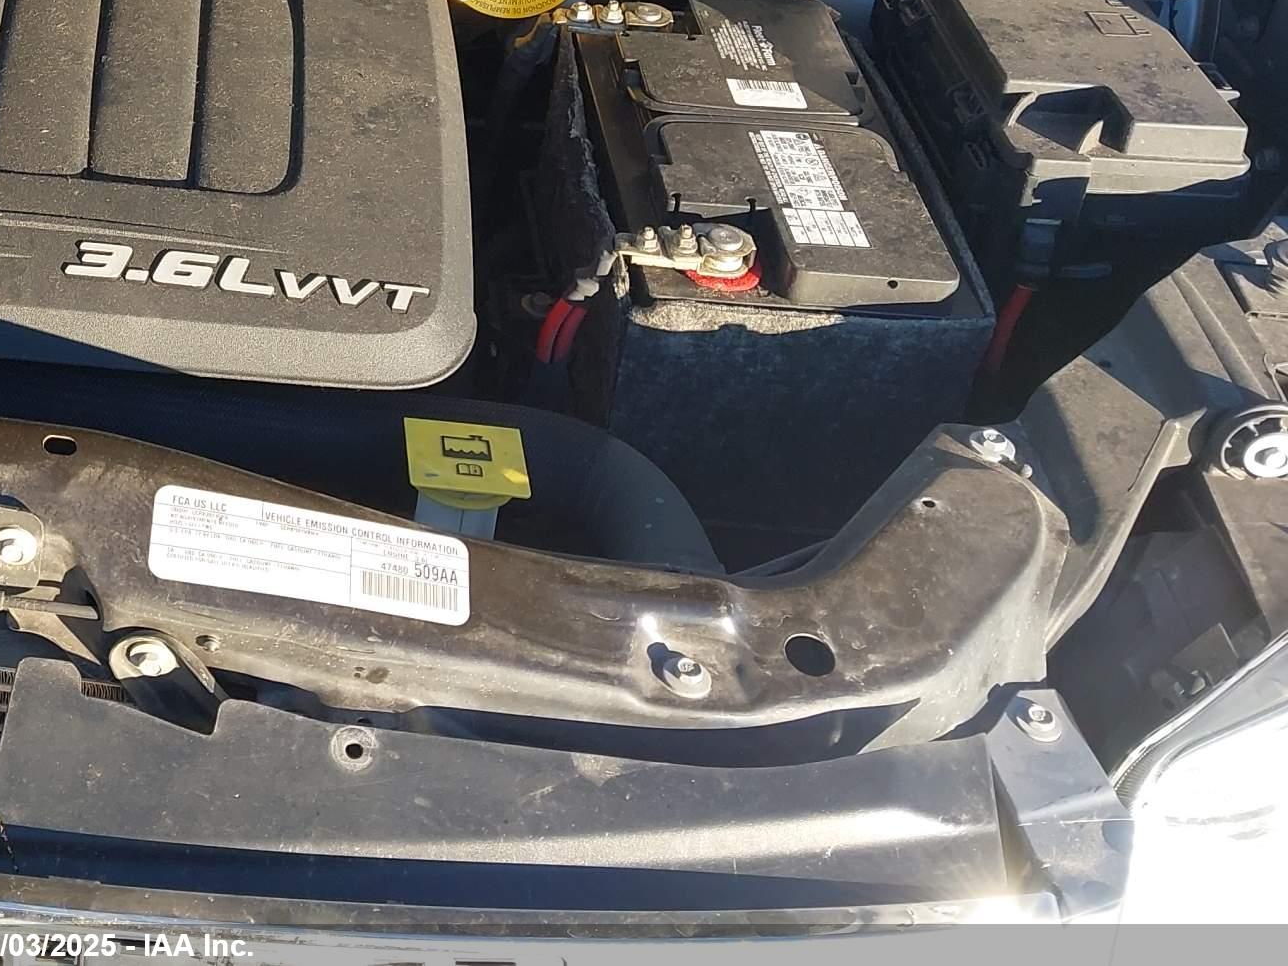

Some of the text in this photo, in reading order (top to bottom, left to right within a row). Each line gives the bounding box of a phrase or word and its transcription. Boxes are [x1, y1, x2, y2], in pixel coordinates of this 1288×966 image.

[512, 7, 522, 15] DE
[63, 241, 430, 313] 3.6L VVT
[172, 495, 228, 512] FCA US LLC
[265, 511, 302, 526] VEHICLE
[305, 518, 348, 534] EMISSION
[352, 527, 392, 543] CONTROL
[396, 536, 459, 556] INFORMATION
[414, 563, 459, 584] 509AA
